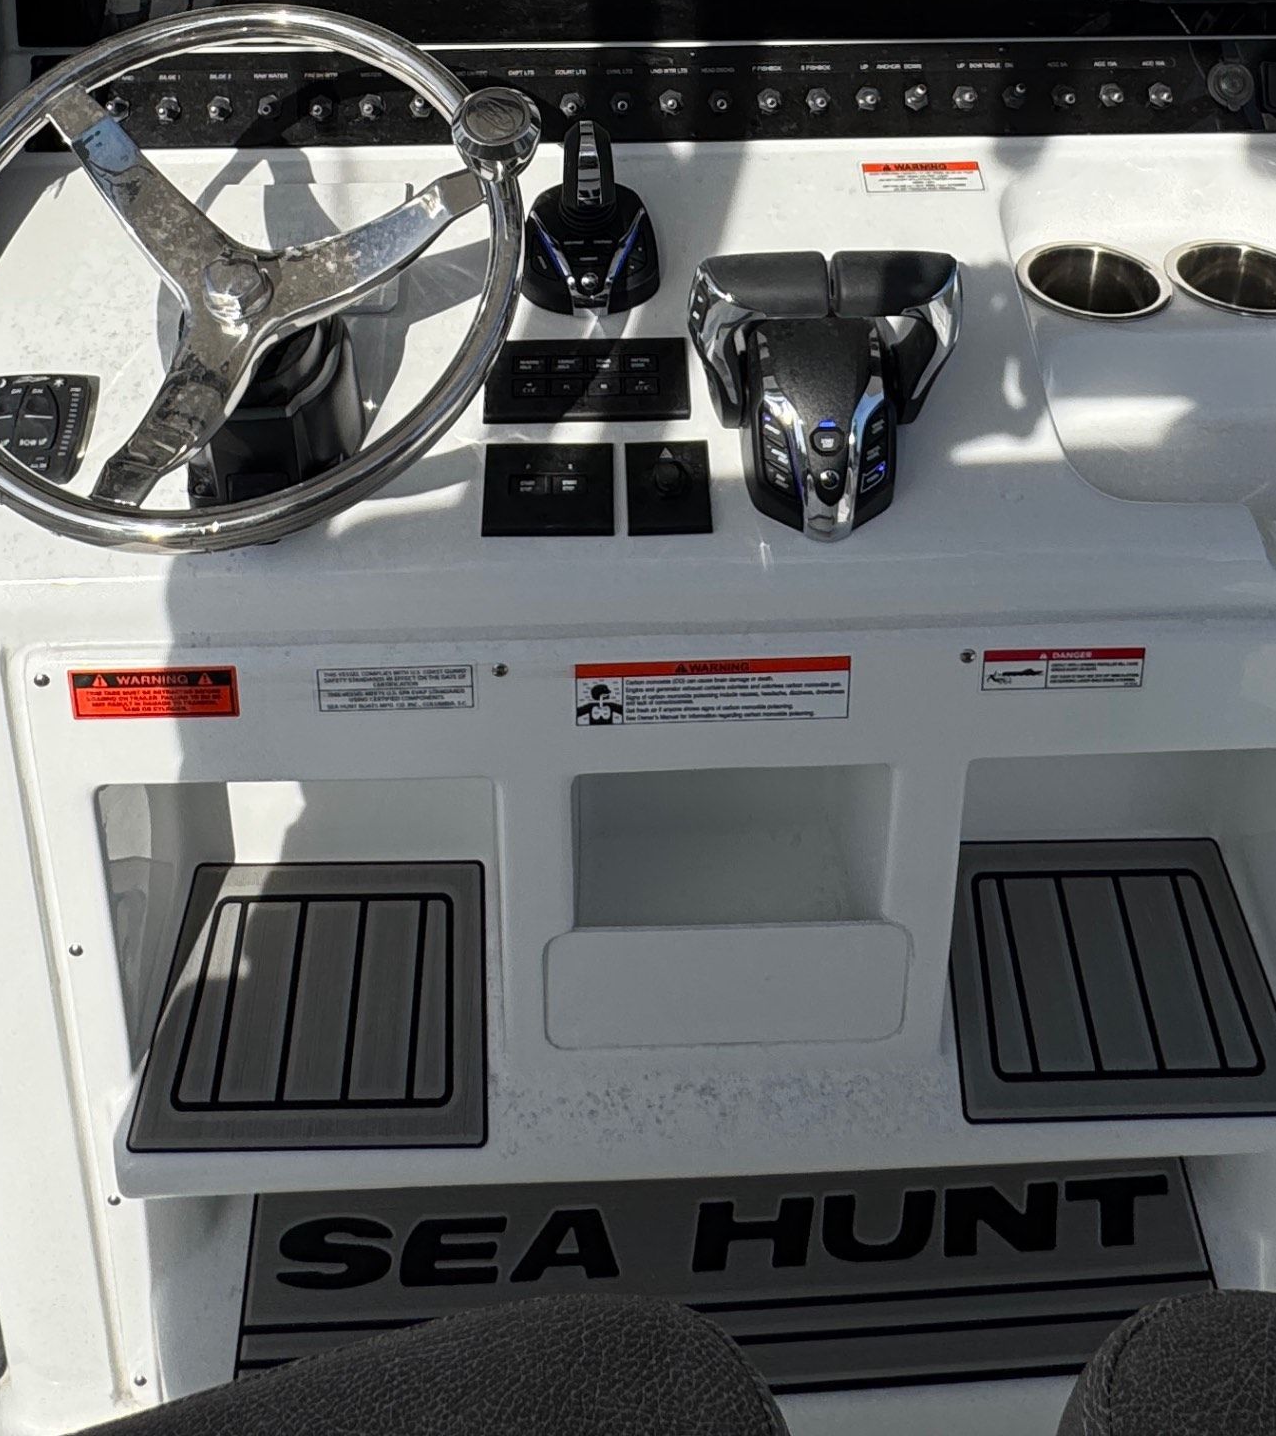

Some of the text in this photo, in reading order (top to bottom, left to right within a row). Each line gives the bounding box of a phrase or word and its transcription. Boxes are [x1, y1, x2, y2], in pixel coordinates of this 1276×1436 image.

[895, 163, 947, 171] WARNING
[19, 437, 48, 447] BOW UP
[690, 662, 750, 673] WARNING
[116, 674, 189, 685] WARNING
[276, 1174, 1169, 1290] SEA HUNT
